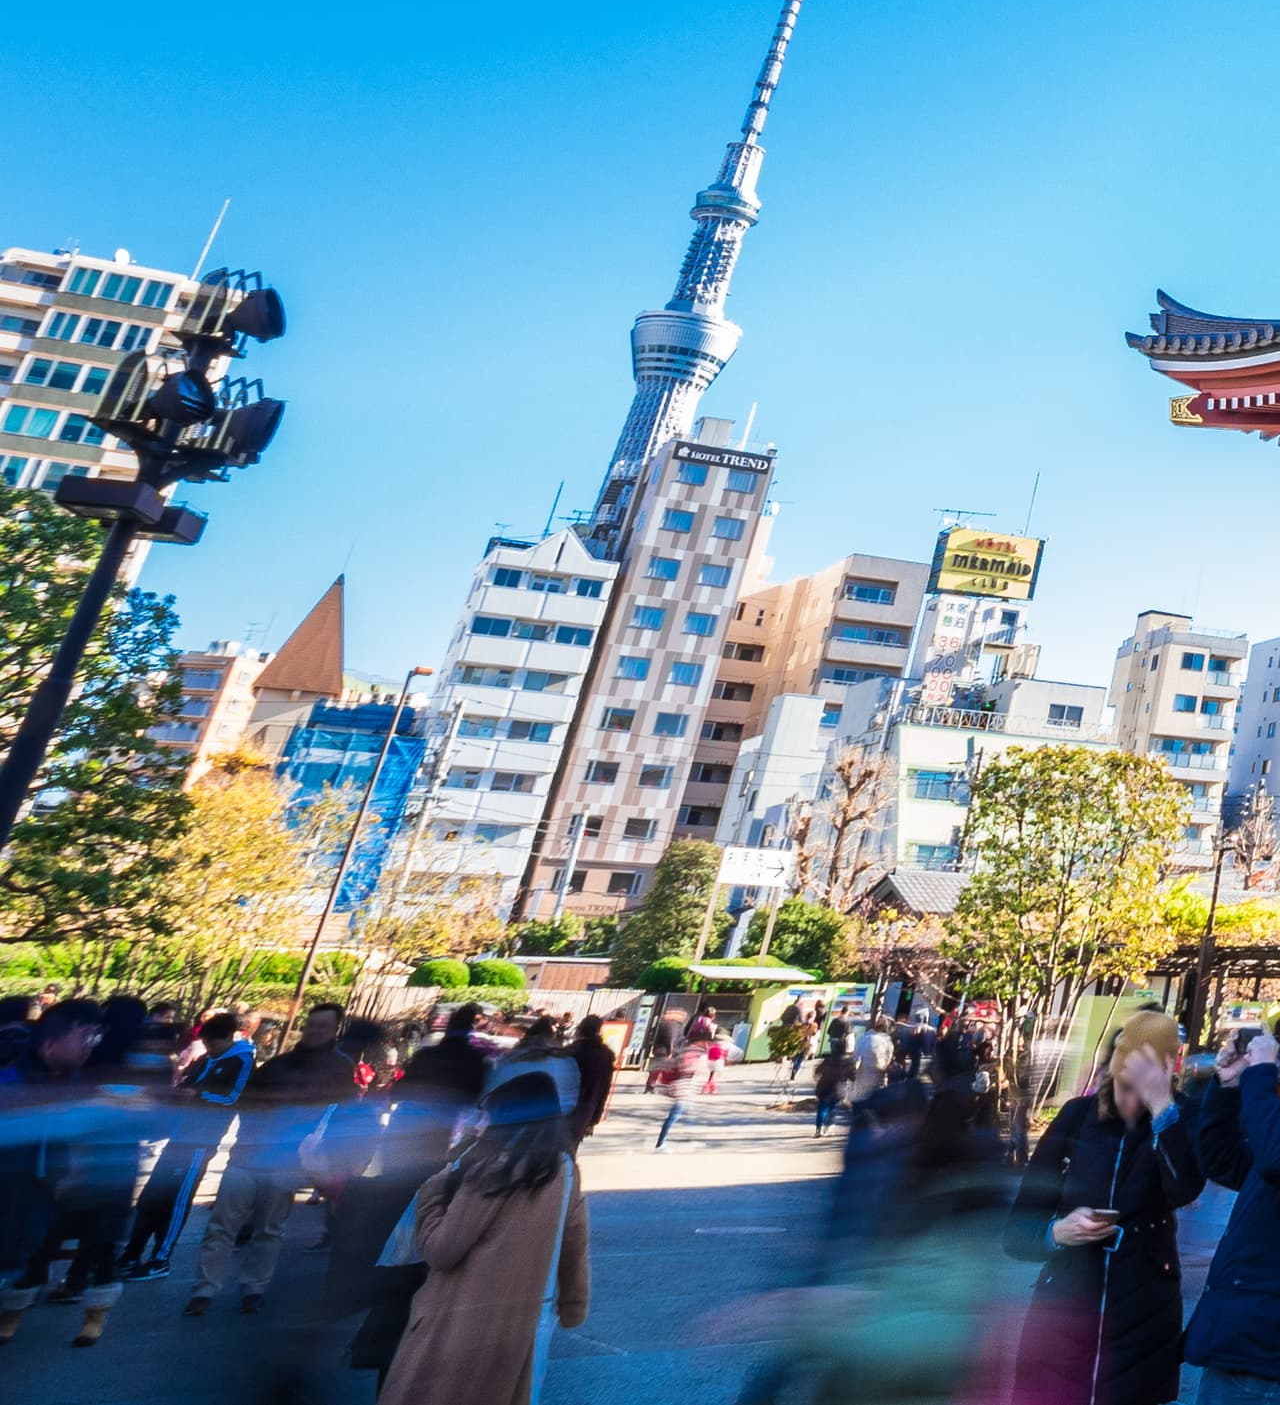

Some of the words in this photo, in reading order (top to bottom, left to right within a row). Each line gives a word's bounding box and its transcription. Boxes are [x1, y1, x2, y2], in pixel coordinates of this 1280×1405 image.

[690, 450, 721, 463] HOTEL
[721, 453, 768, 470] TREND
[976, 538, 1018, 553] HOTEL
[952, 554, 1032, 576] MERMAID
